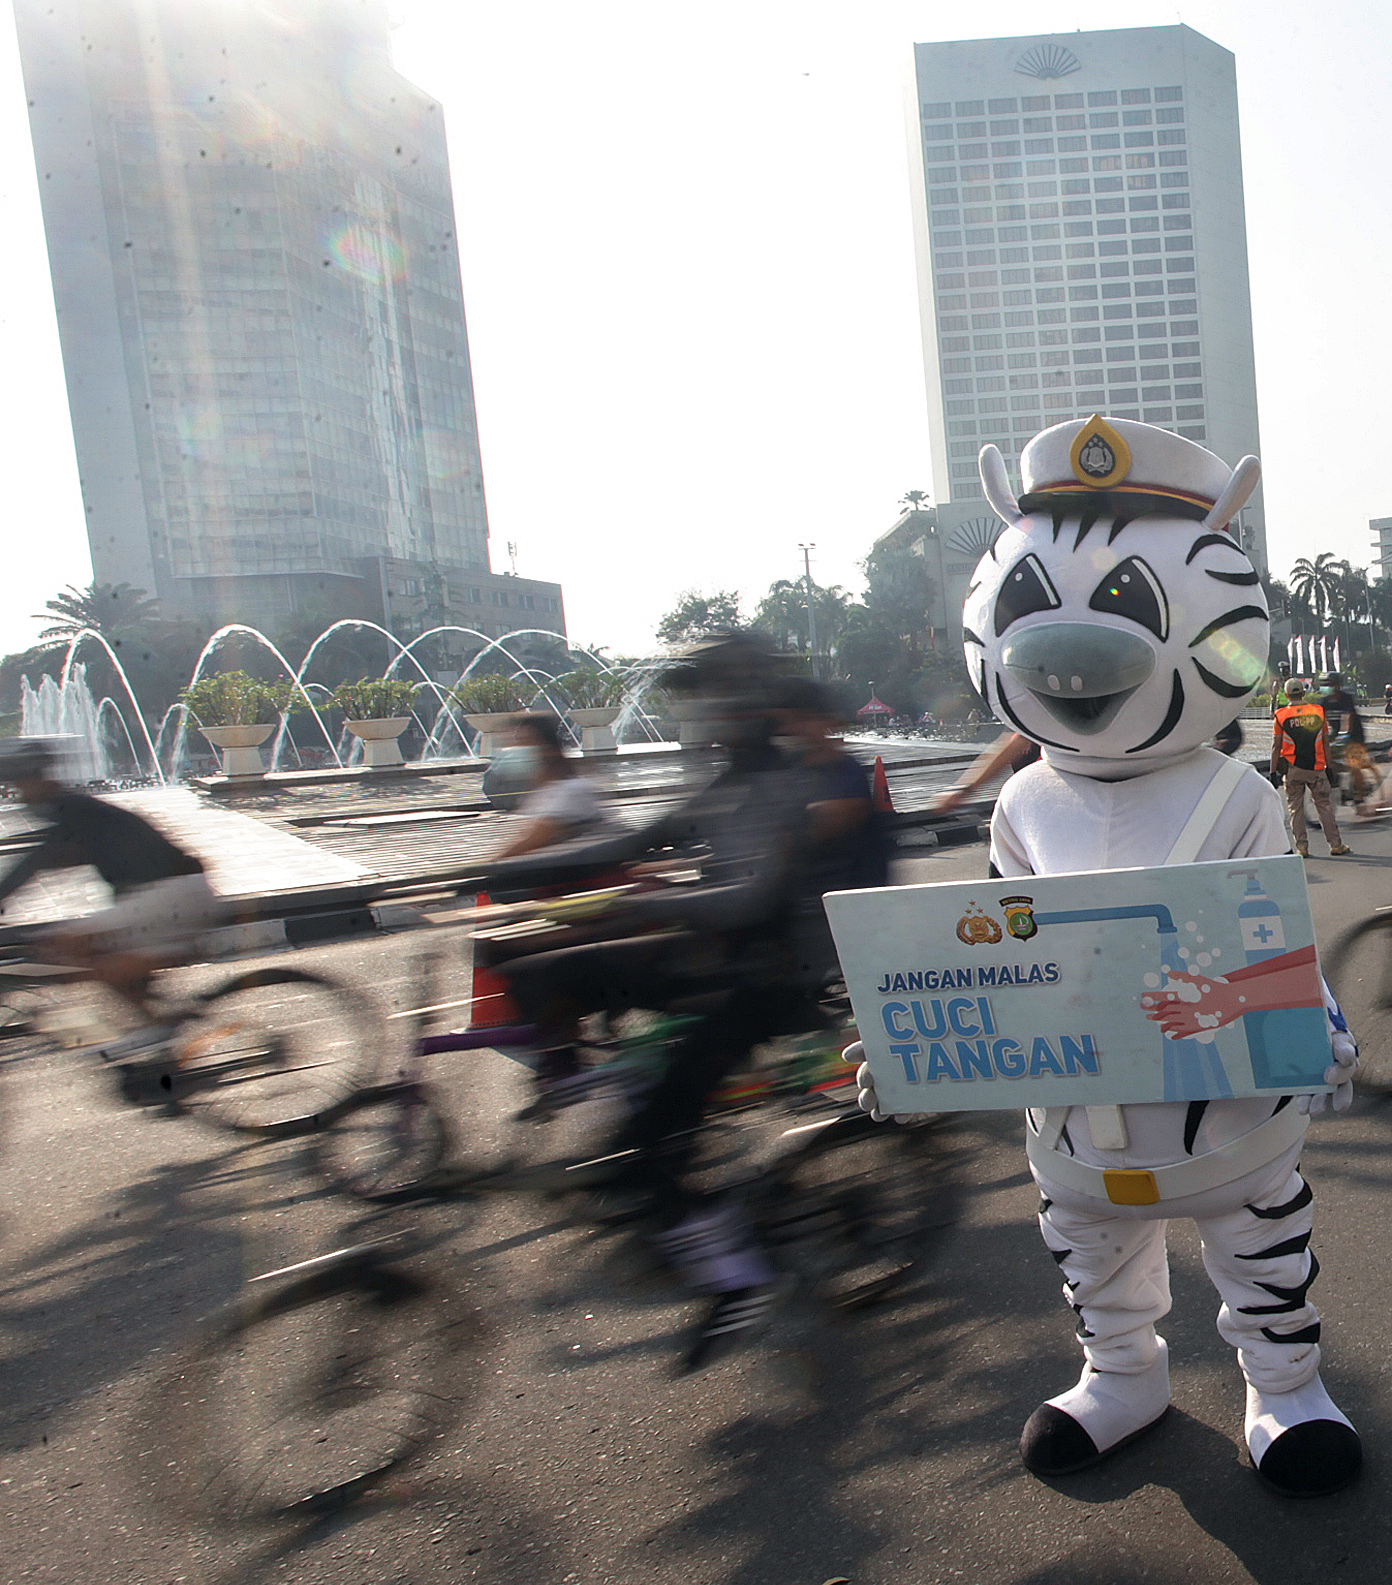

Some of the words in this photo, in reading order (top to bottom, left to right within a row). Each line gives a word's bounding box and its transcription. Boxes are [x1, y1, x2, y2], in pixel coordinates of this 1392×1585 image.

[877, 967, 972, 993] JANGAN
[978, 962, 1060, 987] MALAS
[881, 996, 996, 1041] CUCI
[889, 1034, 1099, 1083] TANGAN
